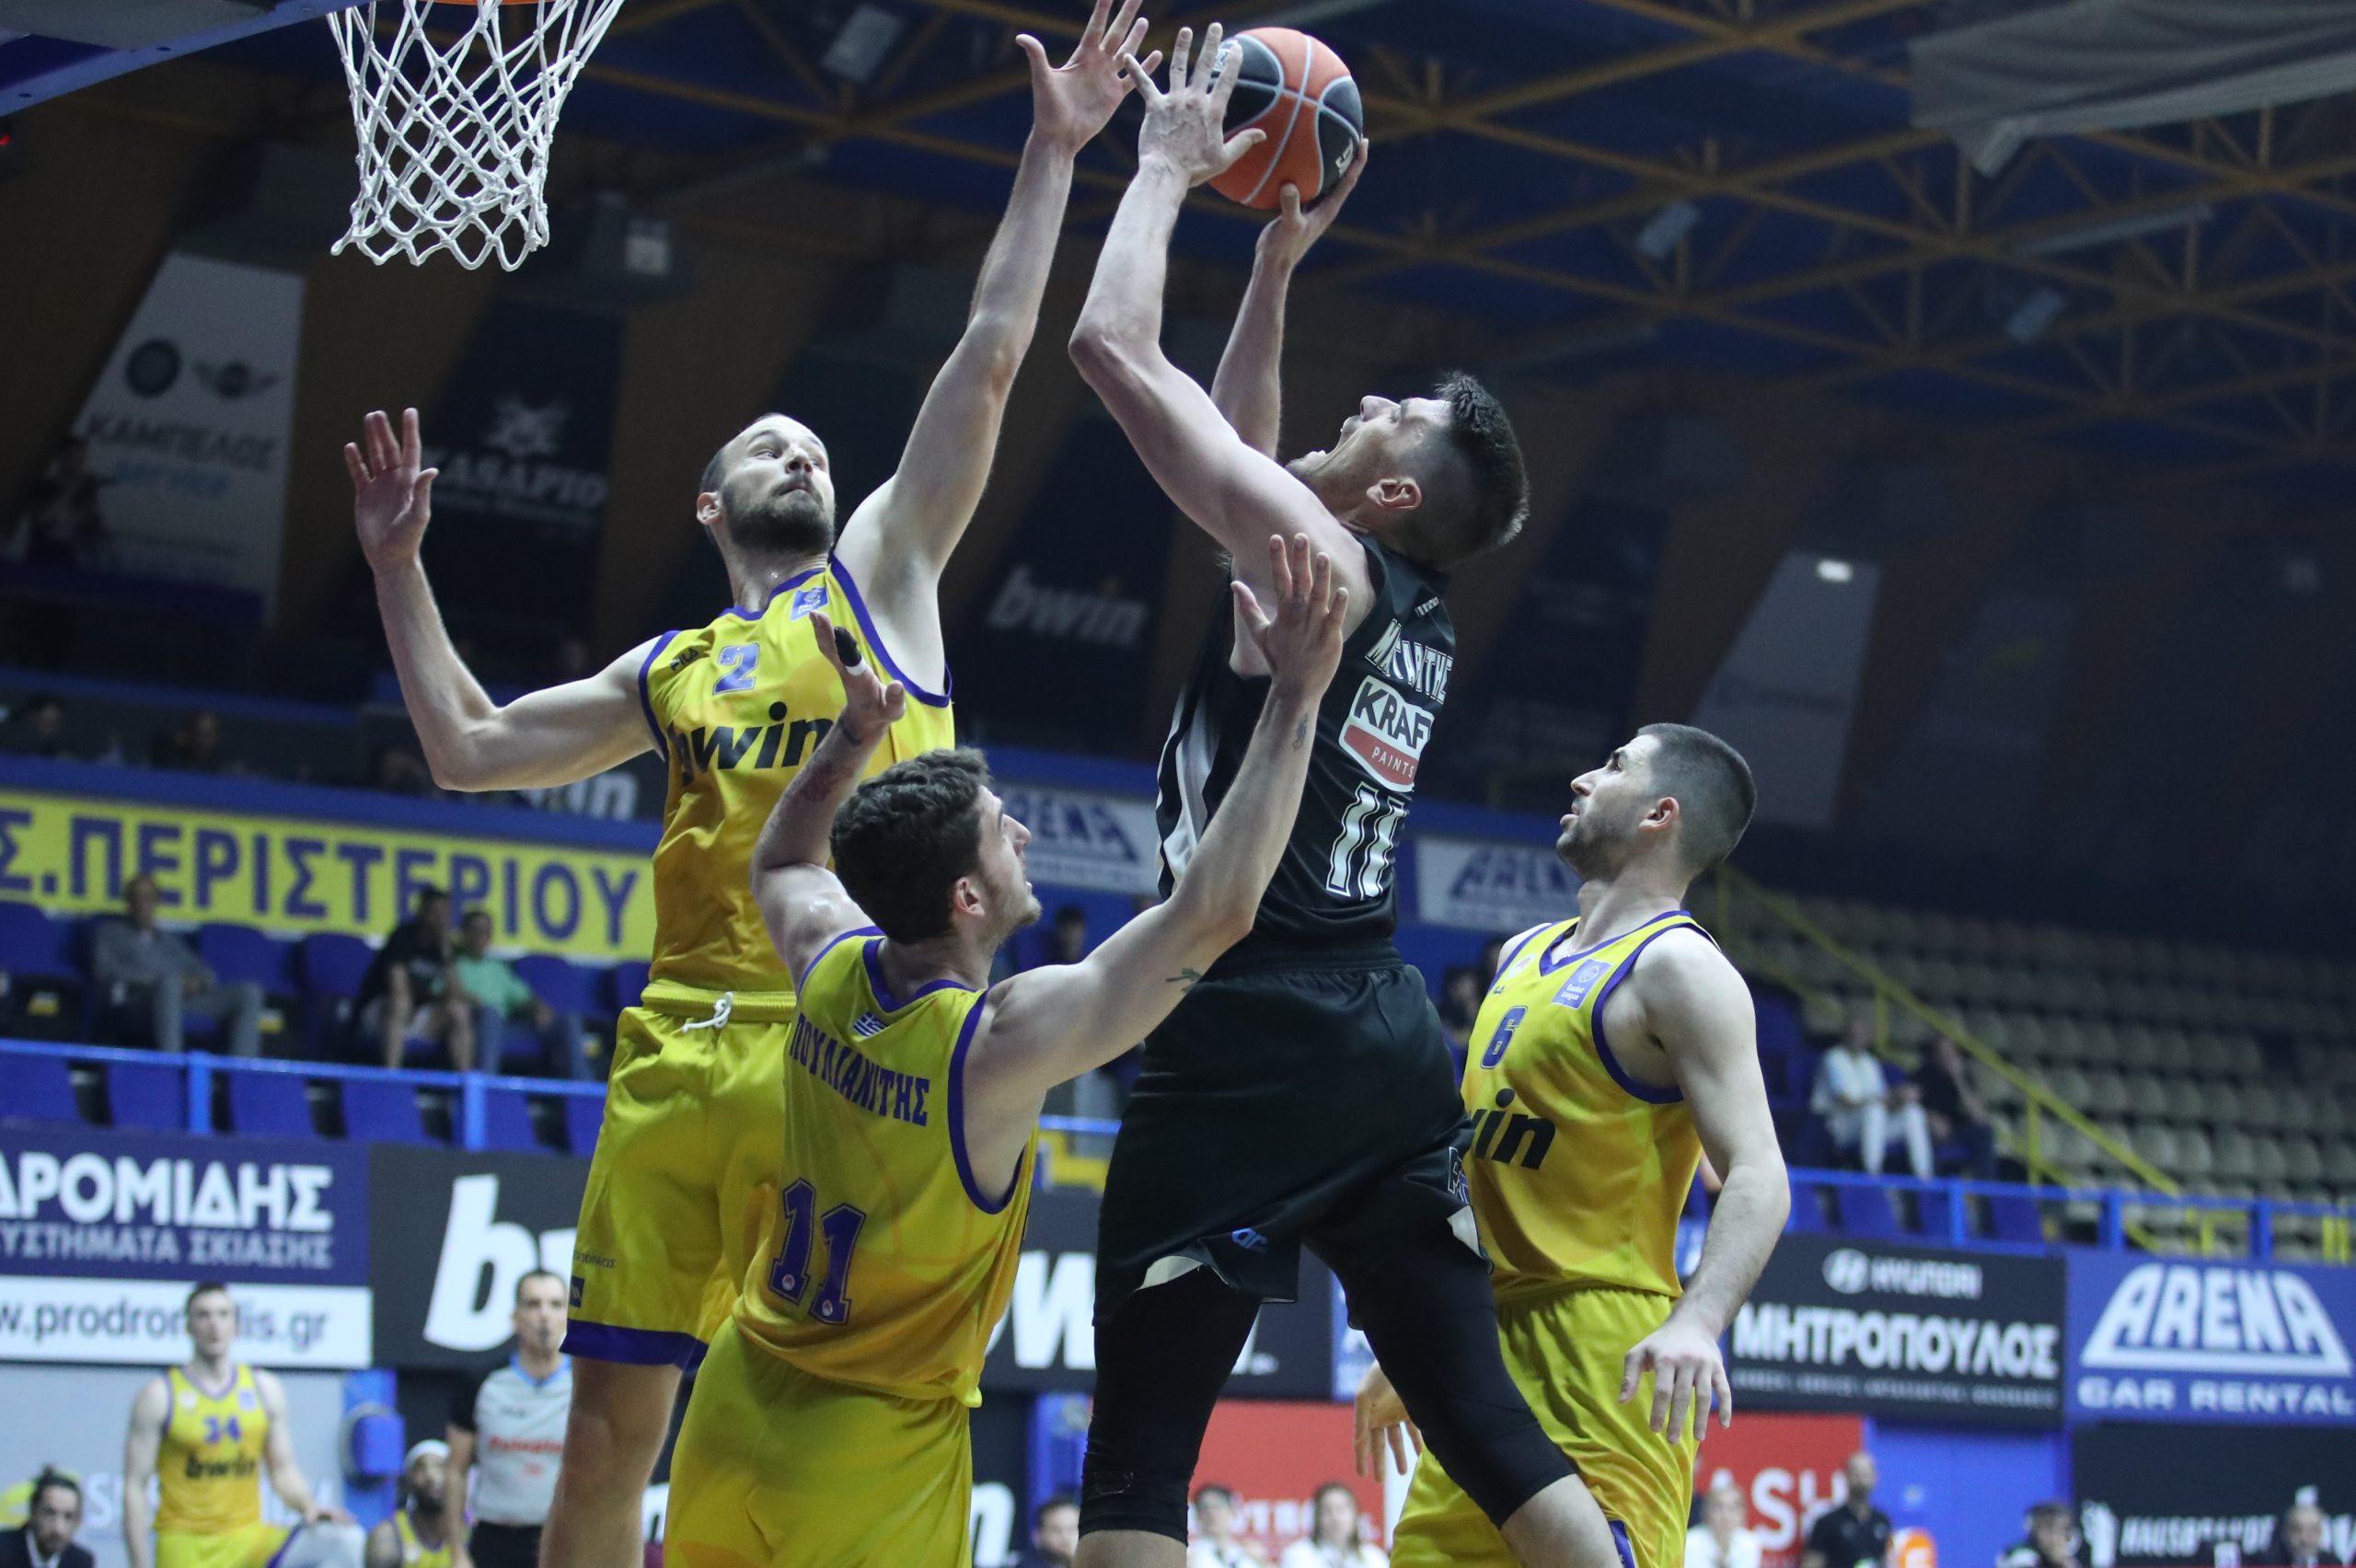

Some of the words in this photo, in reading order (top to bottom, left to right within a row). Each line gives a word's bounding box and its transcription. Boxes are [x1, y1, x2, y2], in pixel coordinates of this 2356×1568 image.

[987, 564, 1149, 647] bwin
[712, 642, 760, 696] 2
[1354, 681, 1432, 750] KRAF
[1370, 745, 1416, 779] PAINTS
[1480, 1006, 1529, 1069] 6
[0, 1221, 181, 1264] ΥΣΤΗΜΑΤΑ
[768, 1177, 867, 1325] 11
[1732, 1301, 2060, 1381] ΜΗΤΡΟΠΟΥΛΟΣ
[2079, 1262, 2352, 1378] ARENA
[2077, 1375, 2177, 1411] CAR
[2189, 1379, 2356, 1418] RENTAL
